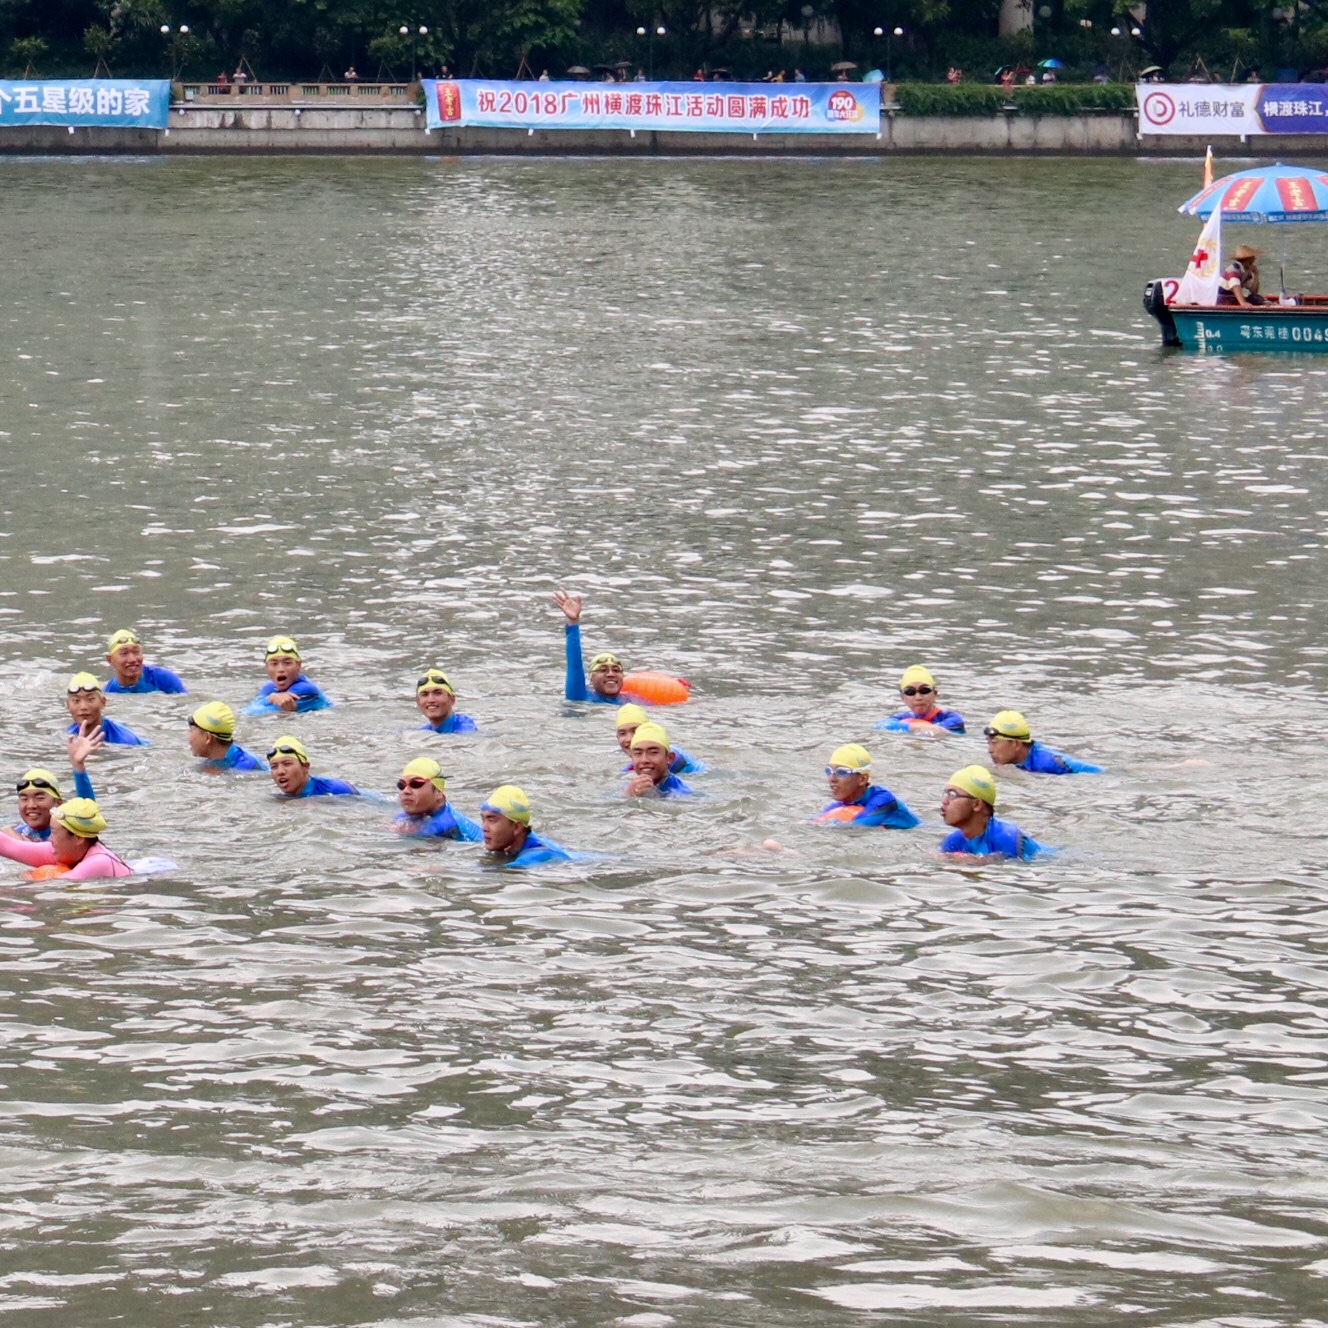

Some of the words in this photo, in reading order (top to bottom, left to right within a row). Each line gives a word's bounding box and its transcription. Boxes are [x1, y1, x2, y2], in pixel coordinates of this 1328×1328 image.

[477, 89, 811, 119] 祝2018广州横渡珠江活动圆满成功
[831, 96, 854, 110] 190
[1178, 100, 1245, 118] 礼德财富
